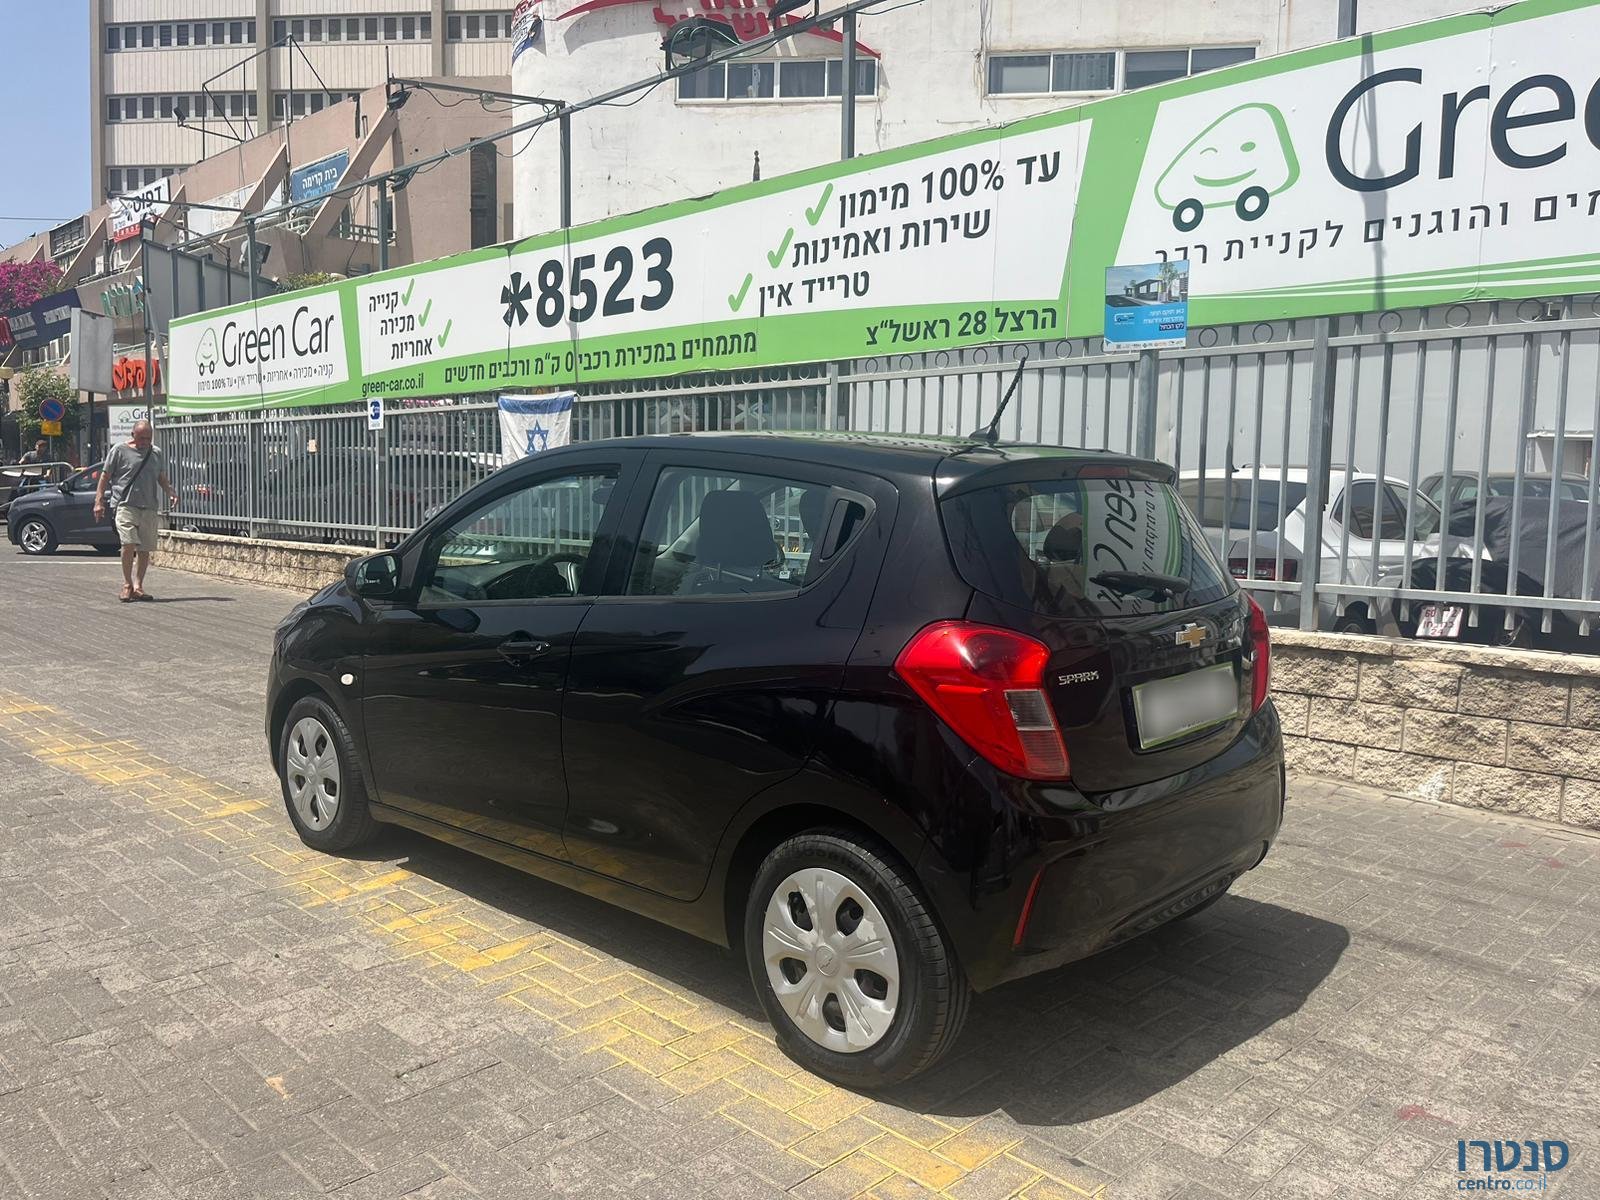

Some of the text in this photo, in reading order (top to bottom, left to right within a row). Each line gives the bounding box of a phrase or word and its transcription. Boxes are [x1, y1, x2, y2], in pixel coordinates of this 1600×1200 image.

[1324, 66, 1600, 193] Gre
[838, 150, 1061, 228] עד 100% מימון
[1363, 201, 1509, 243] והוגנים
[792, 208, 991, 268] שירות ואמינות
[1222, 219, 1344, 261] לקניית
[368, 290, 399, 314] קנייה
[758, 270, 870, 318] טרייד אין
[379, 313, 415, 336] מכירה
[958, 309, 988, 338] 28
[994, 306, 1057, 334] הרצל
[221, 306, 335, 368] Green Car
[390, 337, 433, 361] אחריות
[681, 331, 757, 360] מתמחים
[488, 357, 530, 380] ורכבים
[578, 348, 610, 372] רכבי
[614, 343, 676, 368] במכירת
[211, 378, 226, 390] 100%
[361, 372, 425, 397] green-car.co.il
[444, 361, 485, 384] חדשים
[1058, 670, 1099, 686] SPARK
